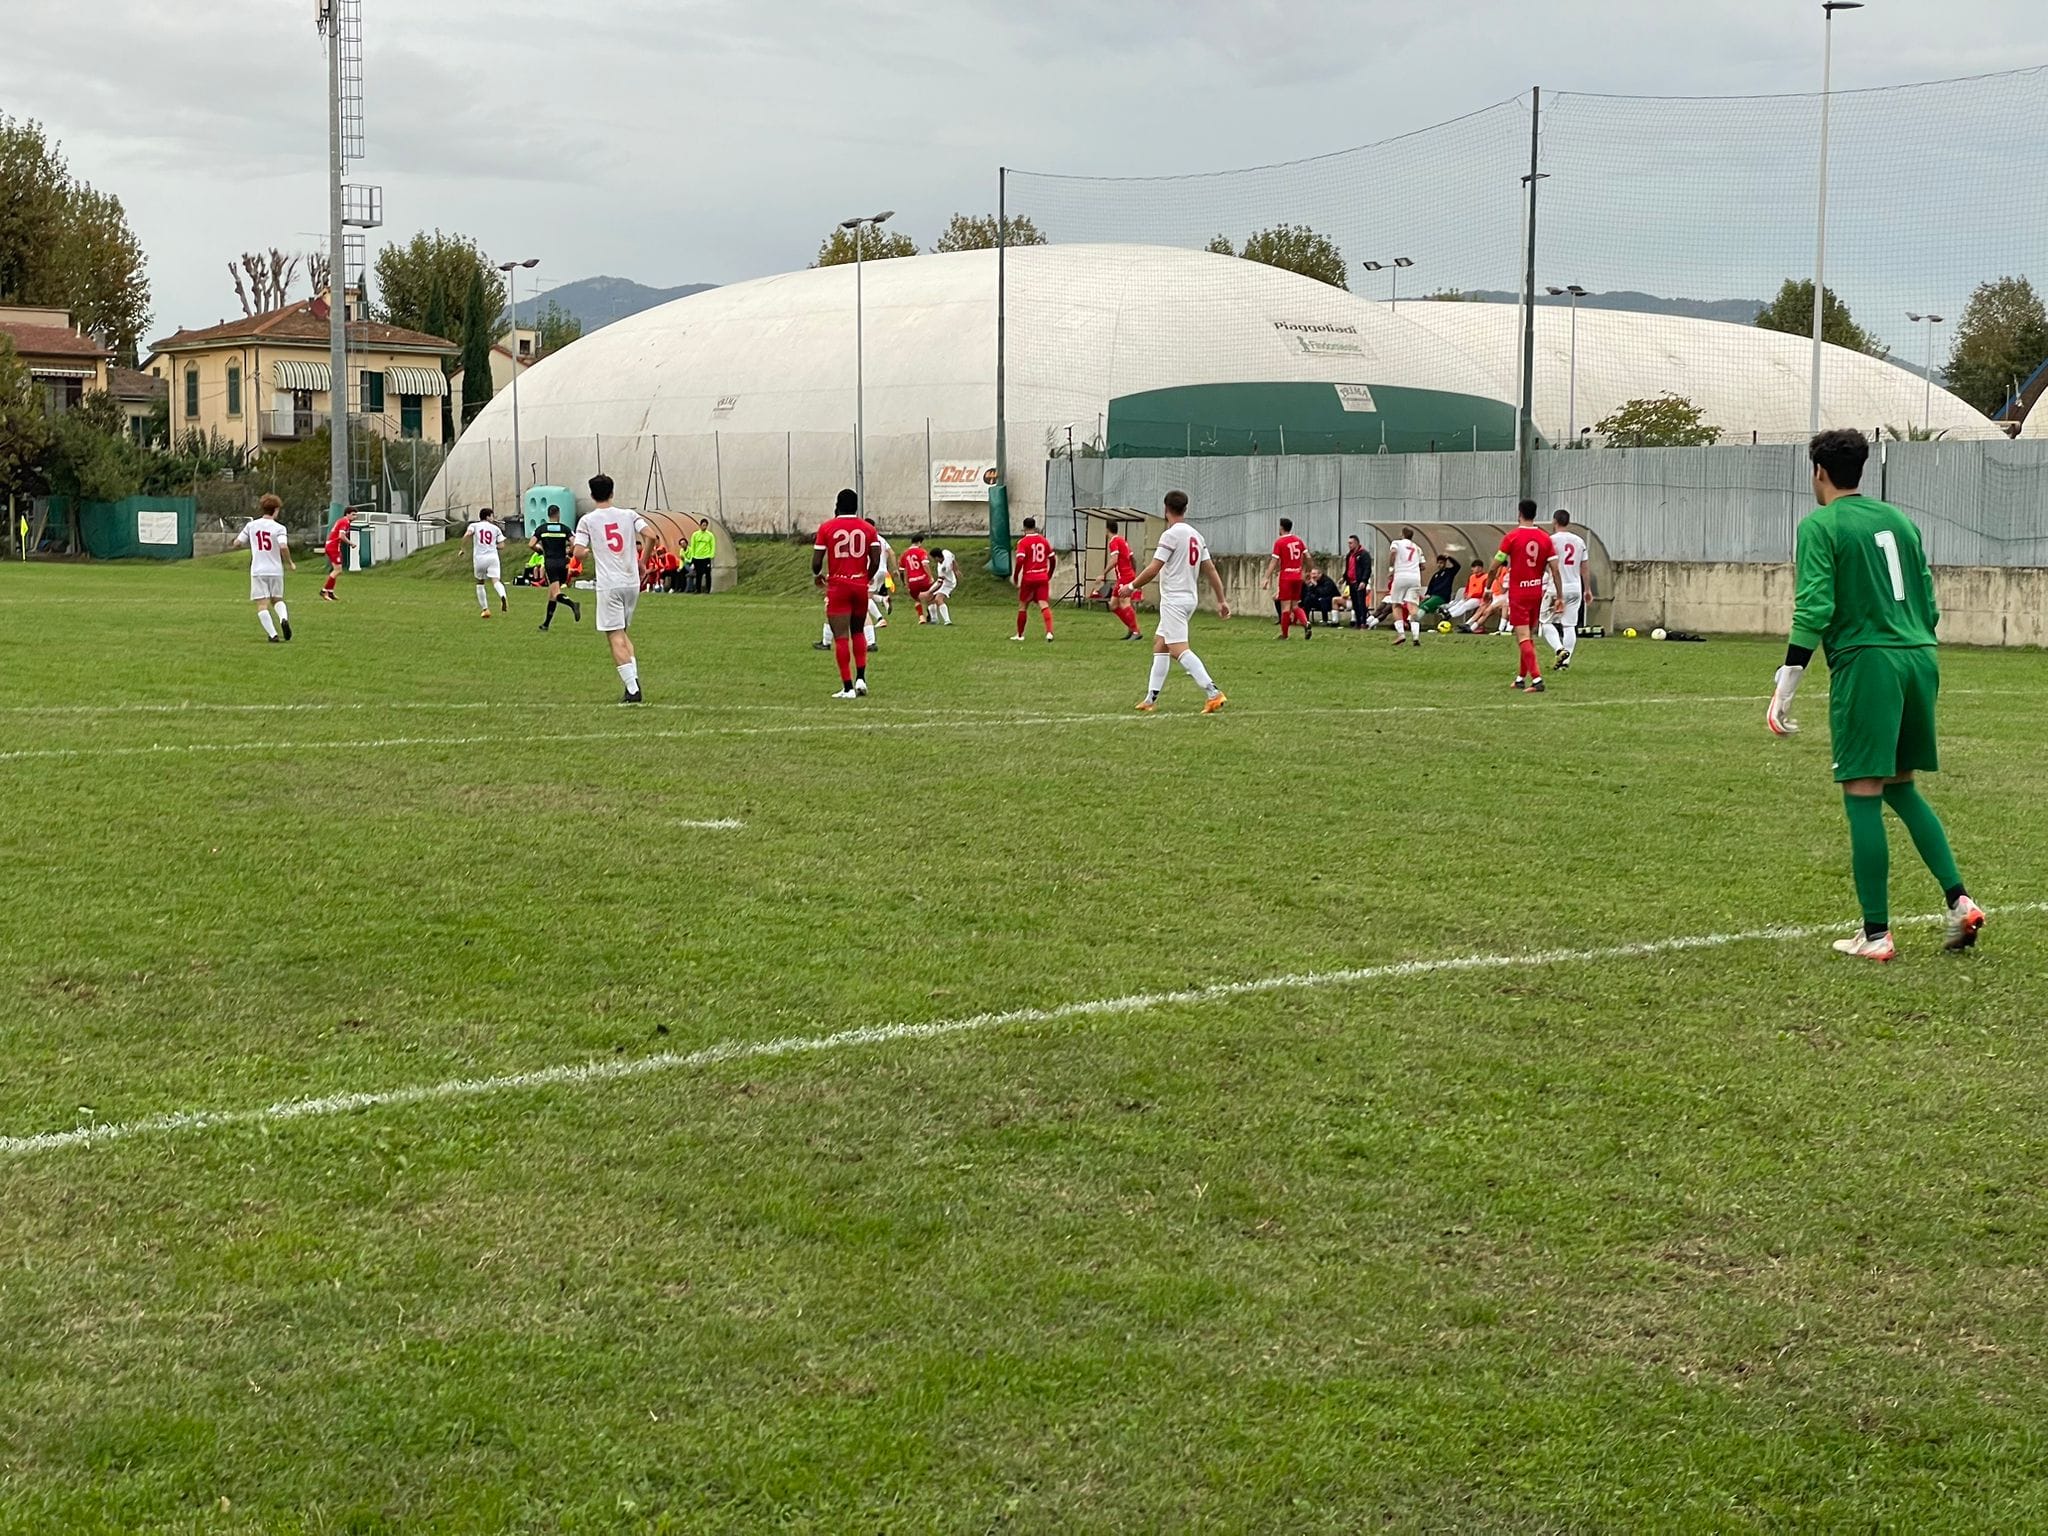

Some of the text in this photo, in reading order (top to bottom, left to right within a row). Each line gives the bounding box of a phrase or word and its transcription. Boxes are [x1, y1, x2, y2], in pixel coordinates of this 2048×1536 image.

[255, 530, 273, 551] 15
[479, 529, 493, 545] 19
[604, 522, 624, 553] 5
[832, 529, 866, 559] 20
[1031, 543, 1045, 562] 18
[1189, 536, 1199, 566] 6
[1287, 541, 1300, 560] 15
[1406, 546, 1416, 561] 7
[1525, 540, 1540, 568] 9
[1564, 543, 1575, 566] 2
[906, 554, 920, 571] 16
[1874, 530, 1905, 601] 1
